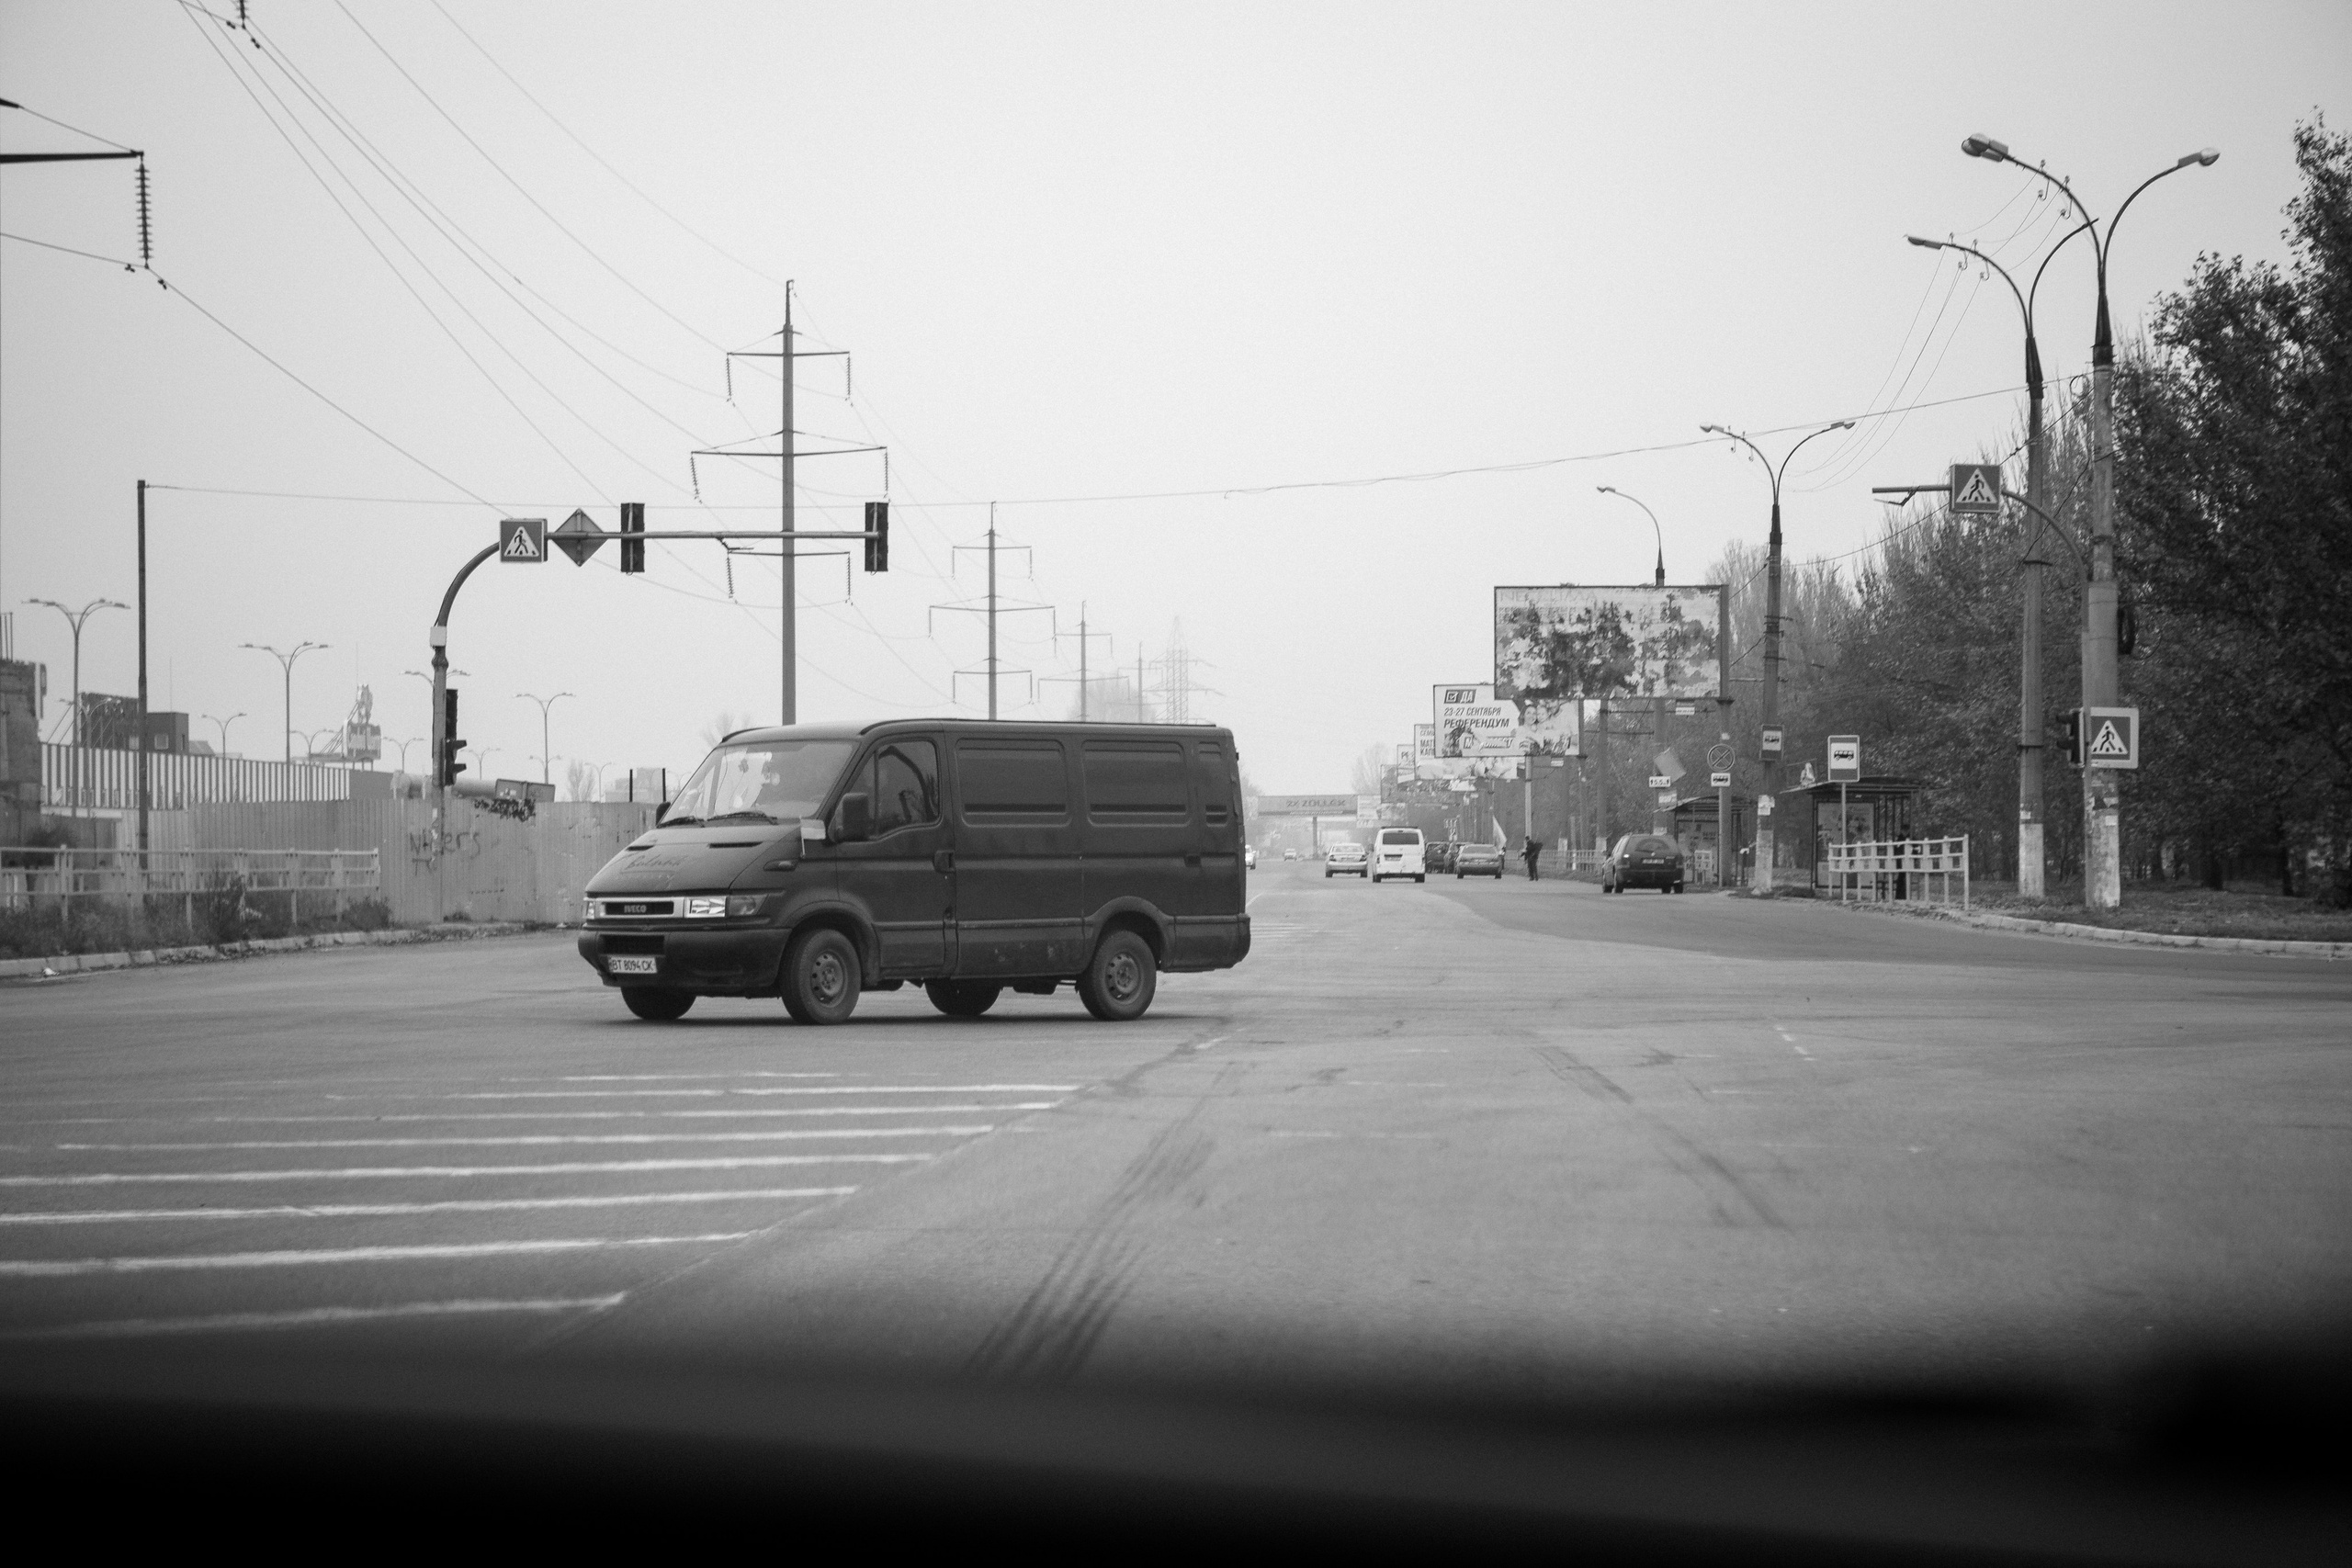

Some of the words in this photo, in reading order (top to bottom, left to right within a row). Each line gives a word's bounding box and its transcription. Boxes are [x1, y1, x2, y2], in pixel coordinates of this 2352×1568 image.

[1460, 691, 1473, 703] ДА
[1443, 707, 1464, 716] 23-27
[1466, 707, 1501, 716] СЕНТЯБРЯ
[1443, 718, 1510, 728] РЕФЕРЕНДУМ
[624, 905, 646, 913] IVECO
[612, 959, 621, 970] BT
